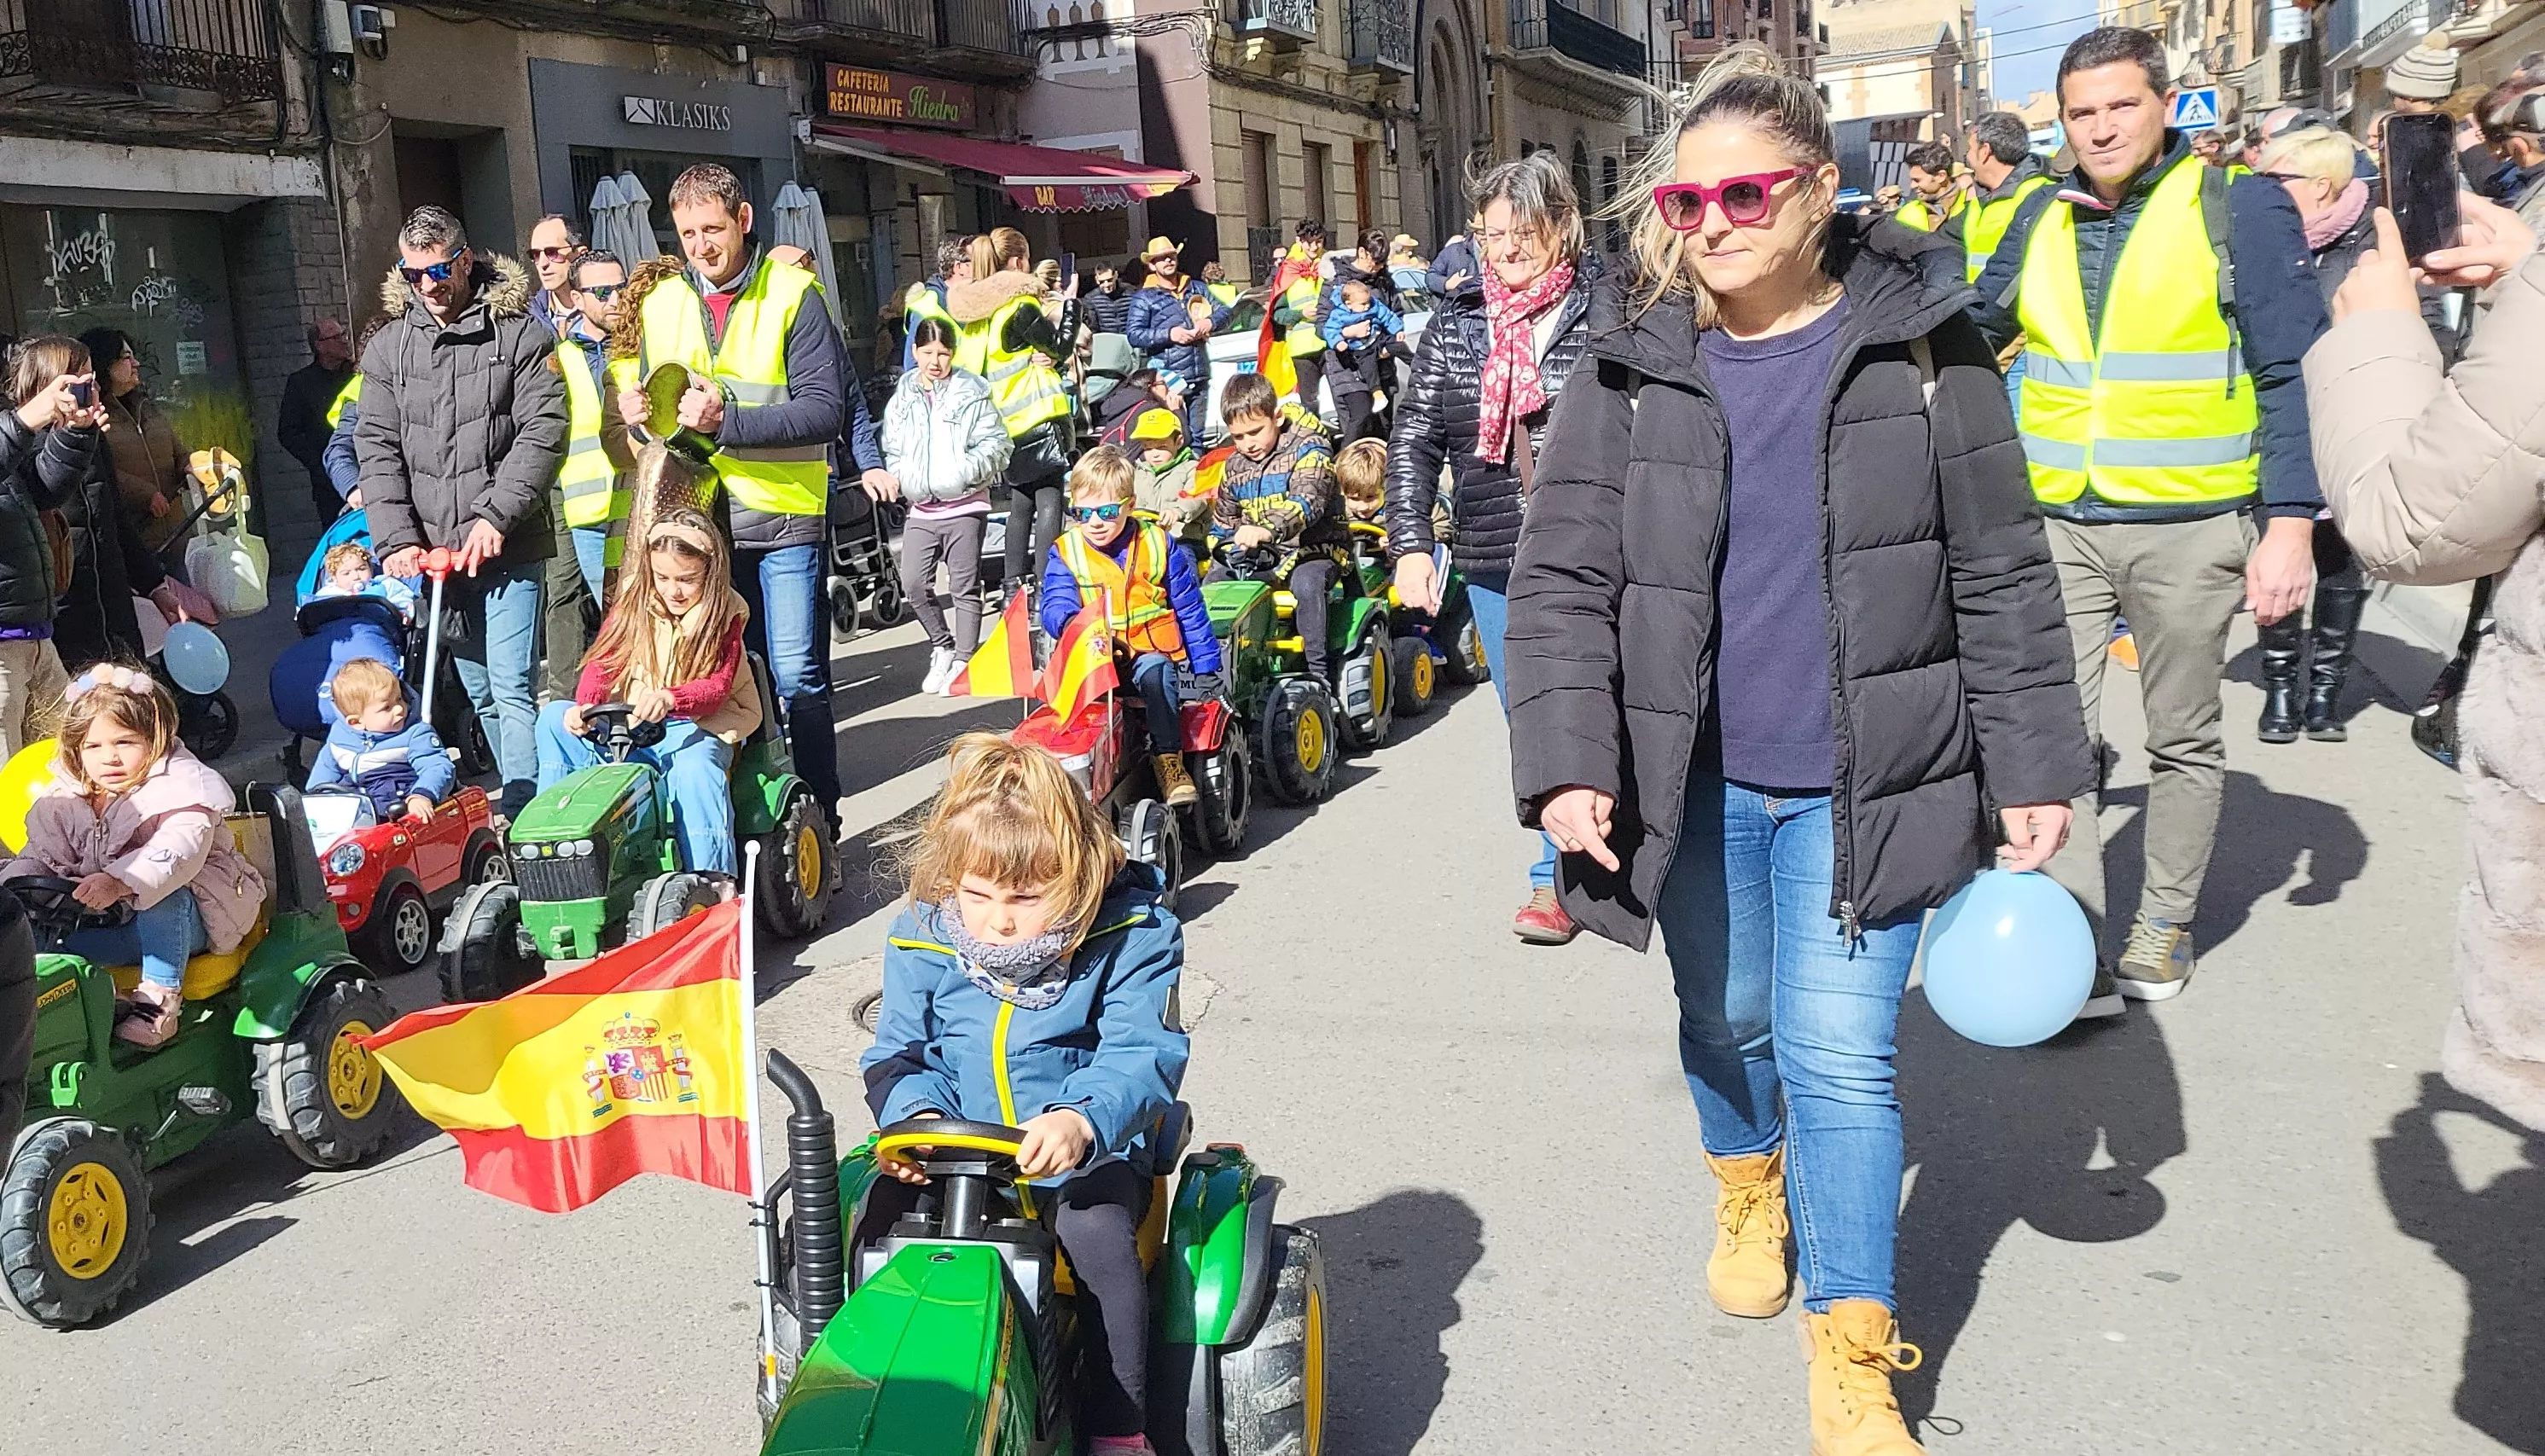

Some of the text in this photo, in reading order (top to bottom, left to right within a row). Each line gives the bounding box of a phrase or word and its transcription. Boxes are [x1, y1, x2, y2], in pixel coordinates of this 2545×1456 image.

[837, 69, 889, 93] CAFETERIA
[656, 100, 731, 131] KLASIKS
[829, 91, 904, 119] RESTAURANTE
[908, 85, 960, 121] Hiedra
[1035, 185, 1056, 206] BAR
